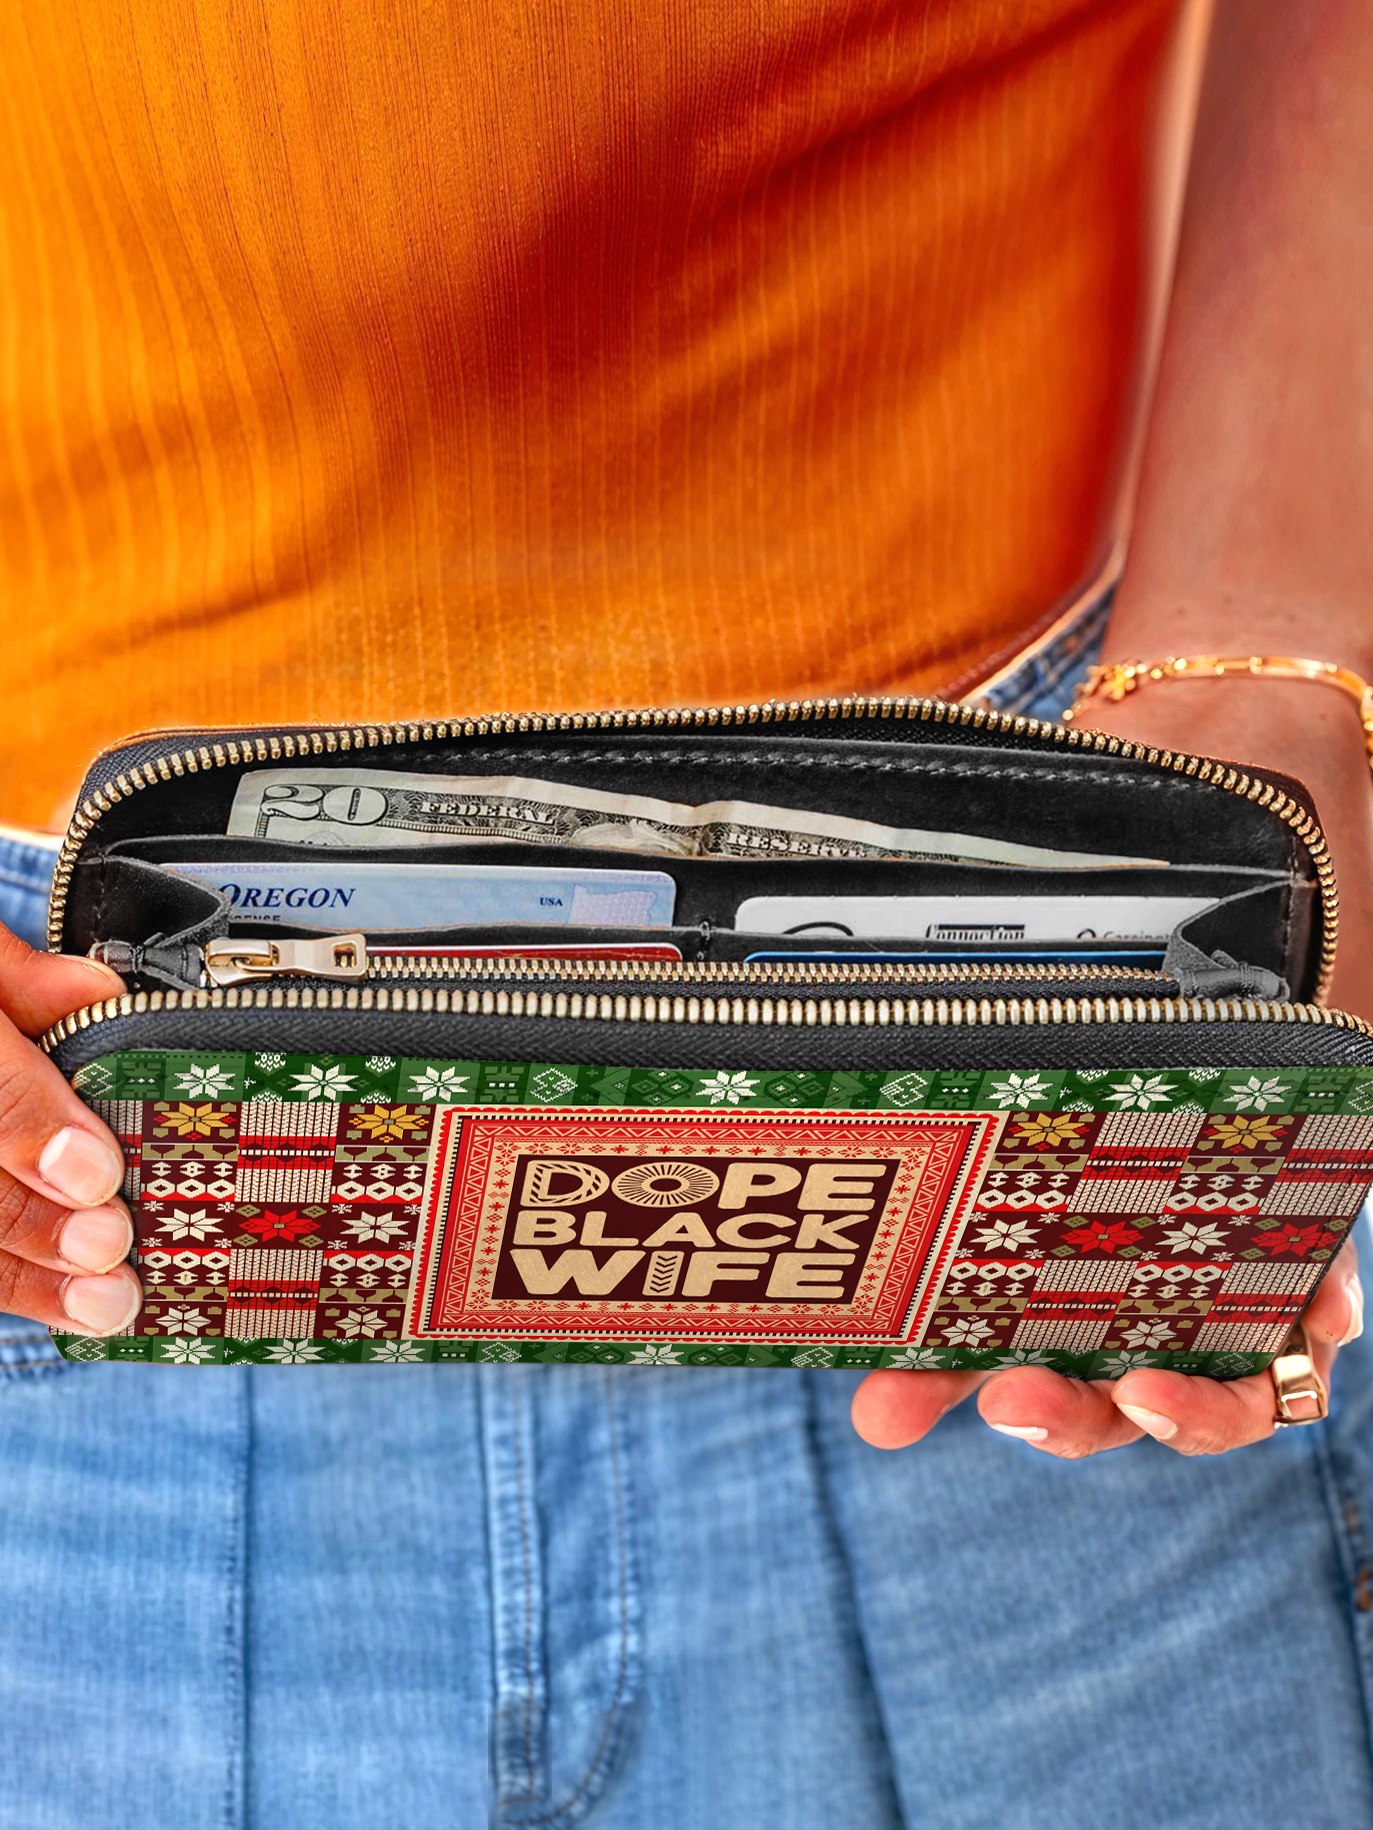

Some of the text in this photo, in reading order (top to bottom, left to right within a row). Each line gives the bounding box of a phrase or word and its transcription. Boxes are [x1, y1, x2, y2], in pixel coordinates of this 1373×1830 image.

[261, 784, 388, 825] 20
[420, 800, 557, 825] FEDERAL
[540, 896, 563, 907] USA
[520, 1160, 887, 1211] DOPE
[512, 1210, 870, 1250] BLACK
[509, 1249, 856, 1299] WIFE
